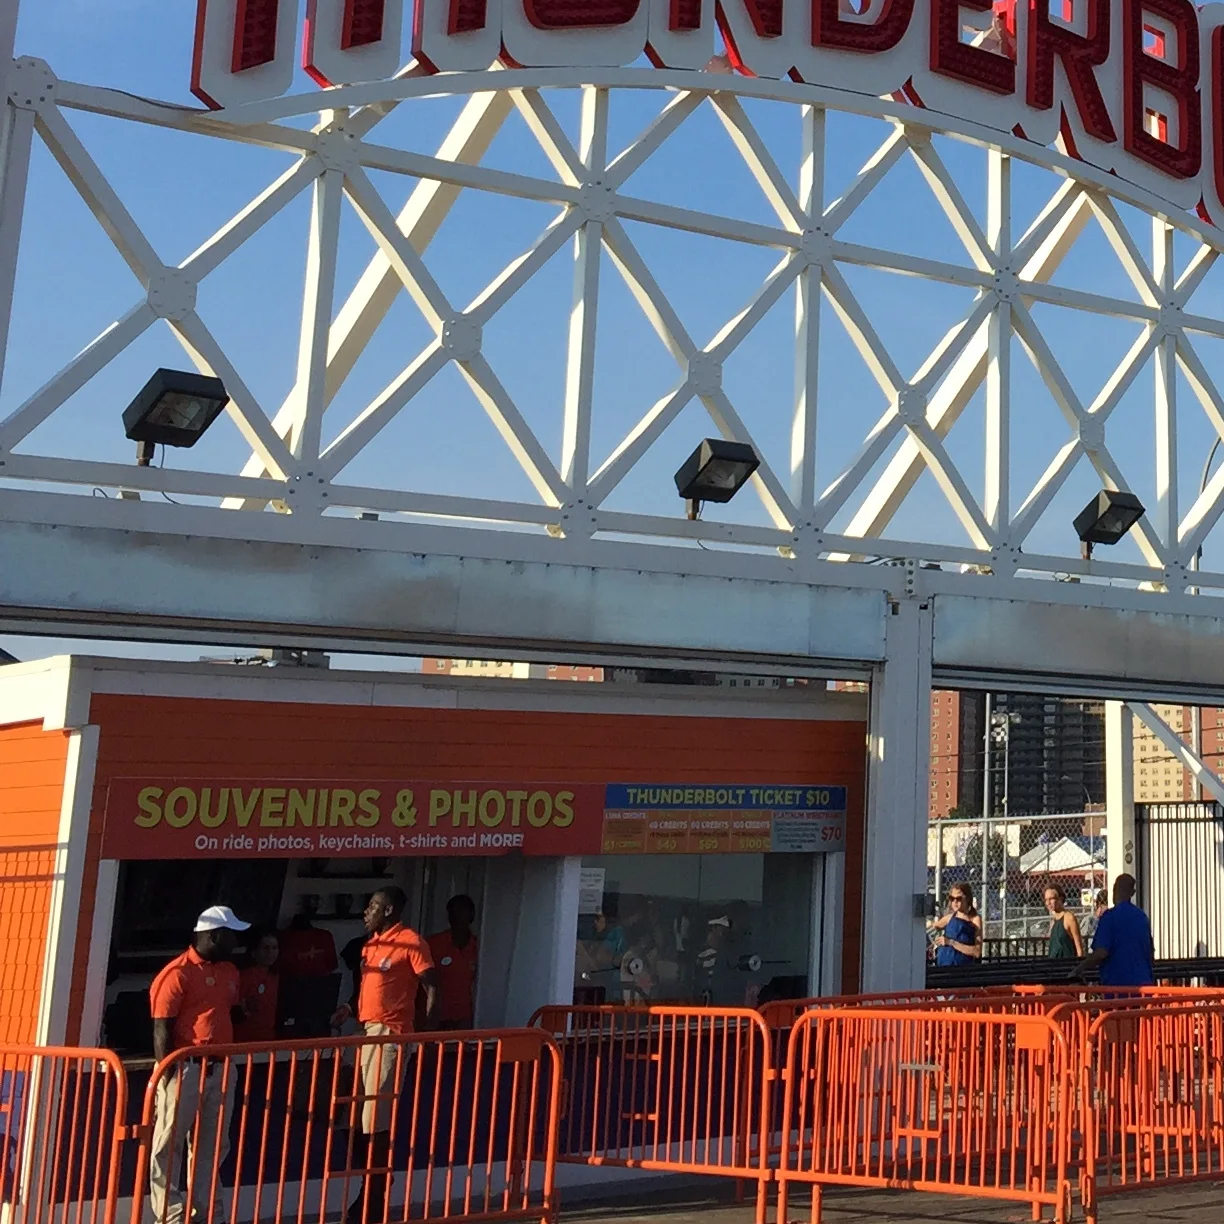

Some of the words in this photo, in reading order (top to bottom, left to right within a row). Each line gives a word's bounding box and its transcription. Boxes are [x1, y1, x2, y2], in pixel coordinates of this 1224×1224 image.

[134, 786, 381, 828] SOUVENIRS
[391, 788, 417, 827] &
[428, 789, 575, 827] PHOTOS
[626, 788, 744, 805] THUNDERBOLT
[749, 789, 803, 805] TICKET
[806, 789, 830, 807] $10
[195, 834, 218, 850] On
[222, 833, 254, 850] ride
[257, 834, 315, 852] photos,
[319, 833, 395, 852] keychains,
[399, 833, 448, 849] t-shirts
[450, 833, 476, 848] and
[479, 833, 525, 848] MORE!
[821, 825, 842, 842] $70
